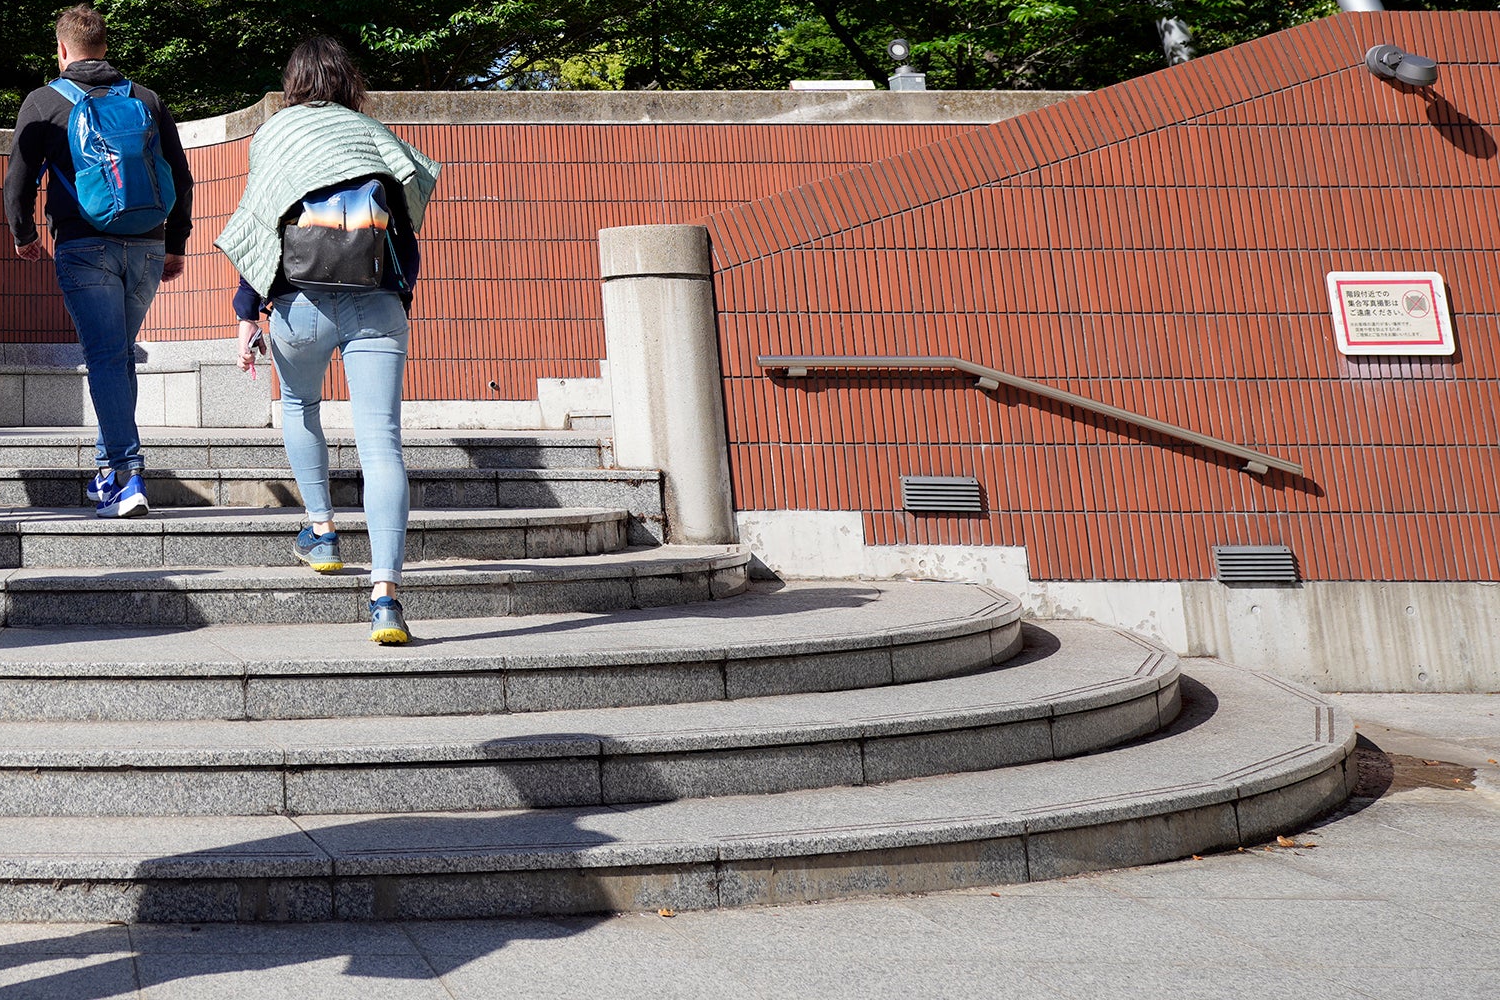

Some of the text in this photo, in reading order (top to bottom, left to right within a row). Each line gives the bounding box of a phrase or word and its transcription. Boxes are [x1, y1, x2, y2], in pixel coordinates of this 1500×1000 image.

[1346, 290, 1390, 298] 階段付近での
[1348, 299, 1399, 307] 集合写真撮影は
[1349, 309, 1404, 317] ご遠慮ください。
